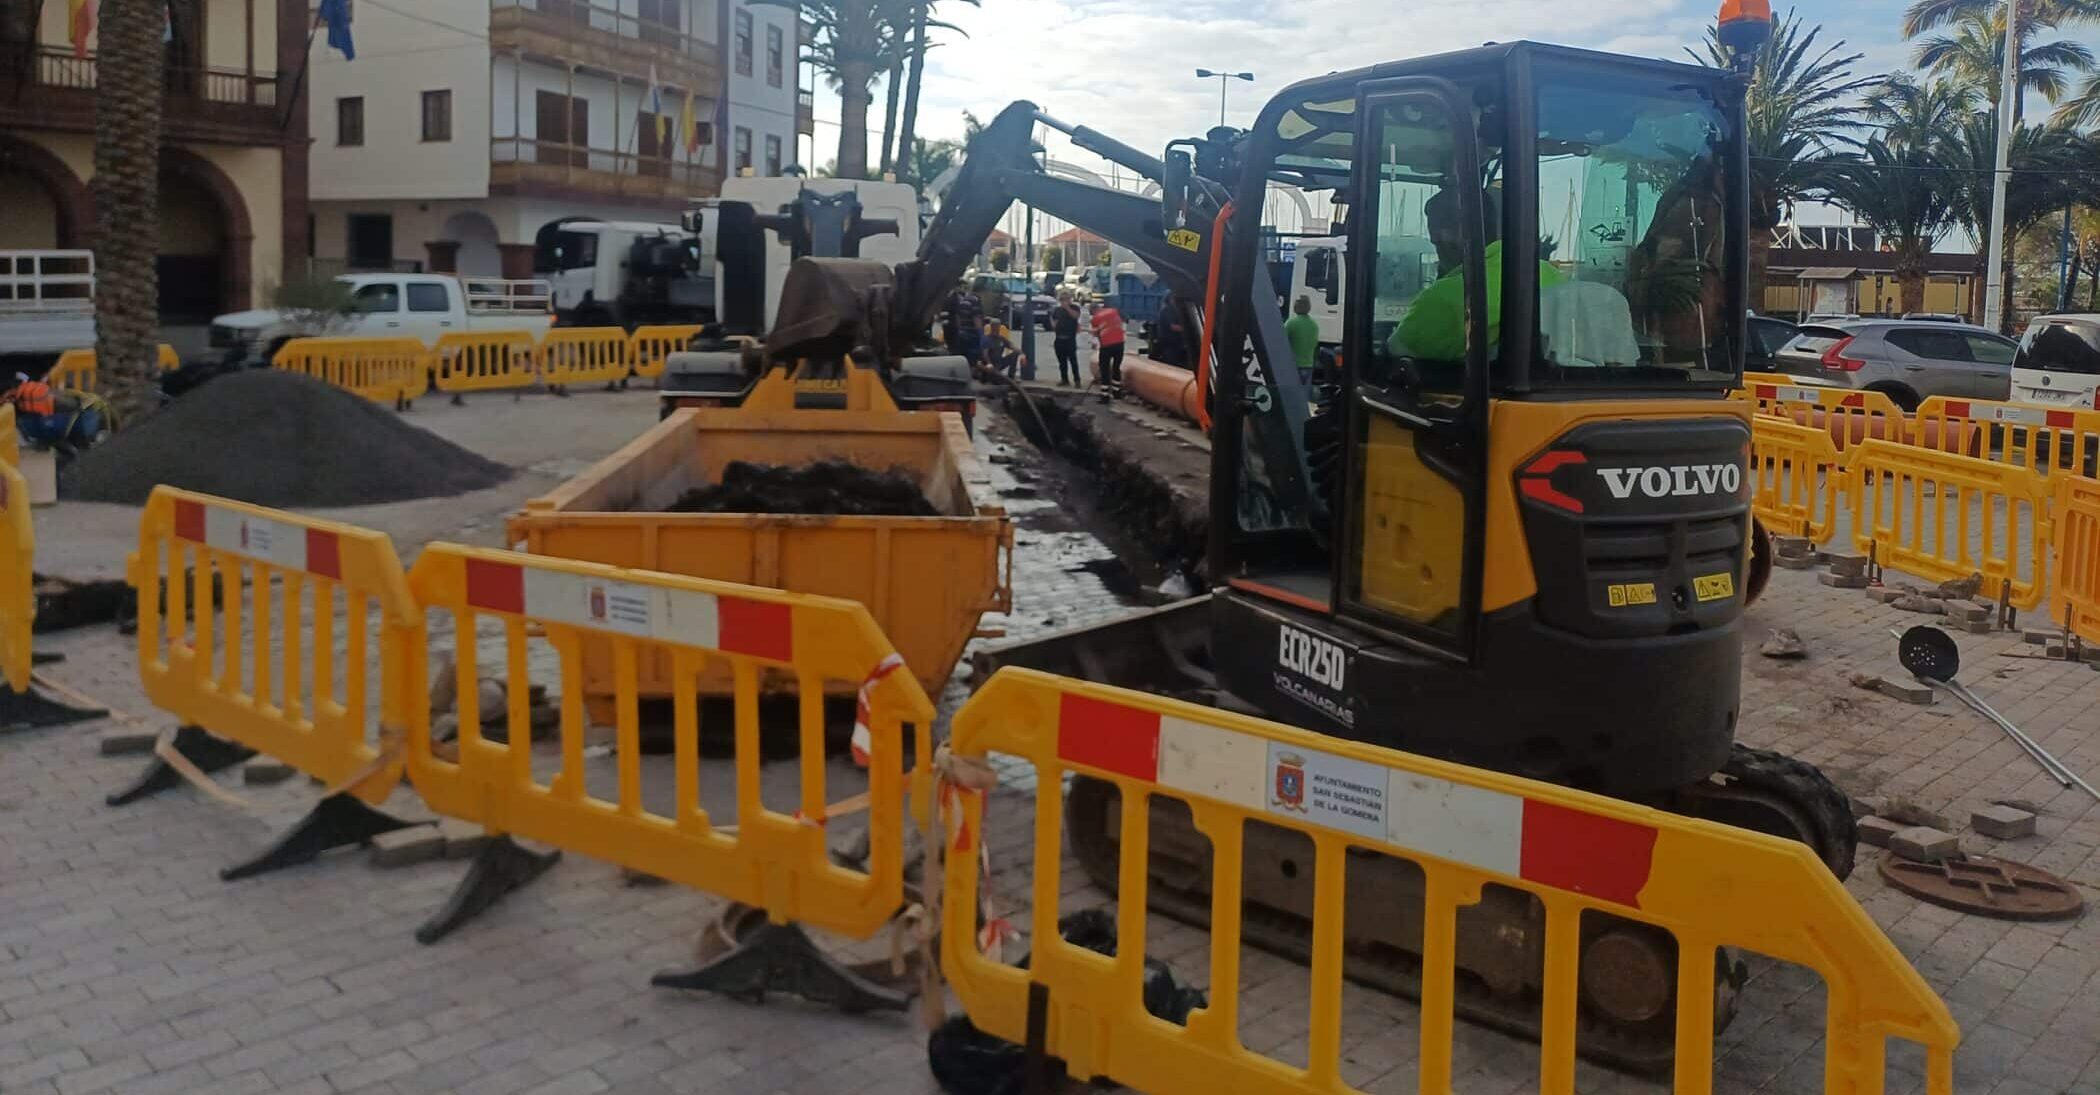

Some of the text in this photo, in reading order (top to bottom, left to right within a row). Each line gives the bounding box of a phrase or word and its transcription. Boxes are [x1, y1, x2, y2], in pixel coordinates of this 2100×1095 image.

[1596, 463, 1741, 499] VOLVO
[1279, 624, 1345, 692] ECR25D
[1312, 786, 1332, 798] SAN
[1313, 774, 1382, 798] AYUNTAMIENTO
[1313, 799, 1380, 822] DE LA GOMERA
